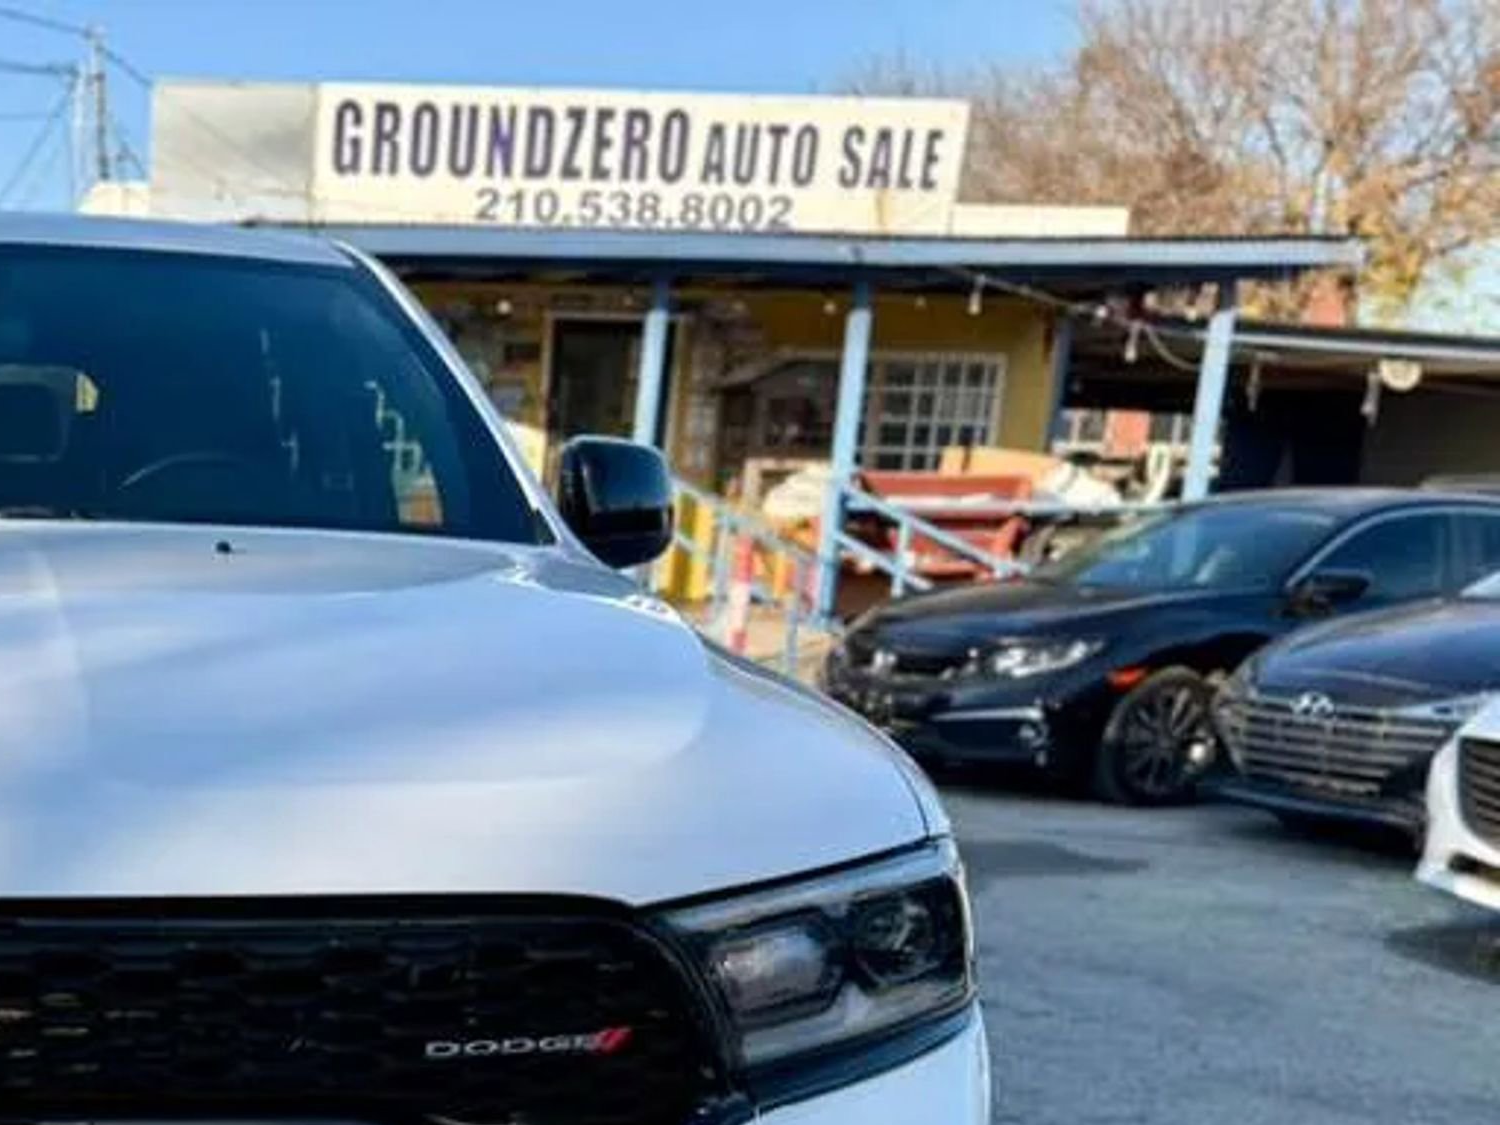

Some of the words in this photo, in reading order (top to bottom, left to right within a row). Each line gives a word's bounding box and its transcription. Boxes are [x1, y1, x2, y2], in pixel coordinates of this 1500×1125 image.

[333, 98, 690, 184] GROUNDZERO
[701, 121, 820, 187] AUTO
[837, 123, 943, 191] SALE
[474, 186, 794, 230] 210.538.8002
